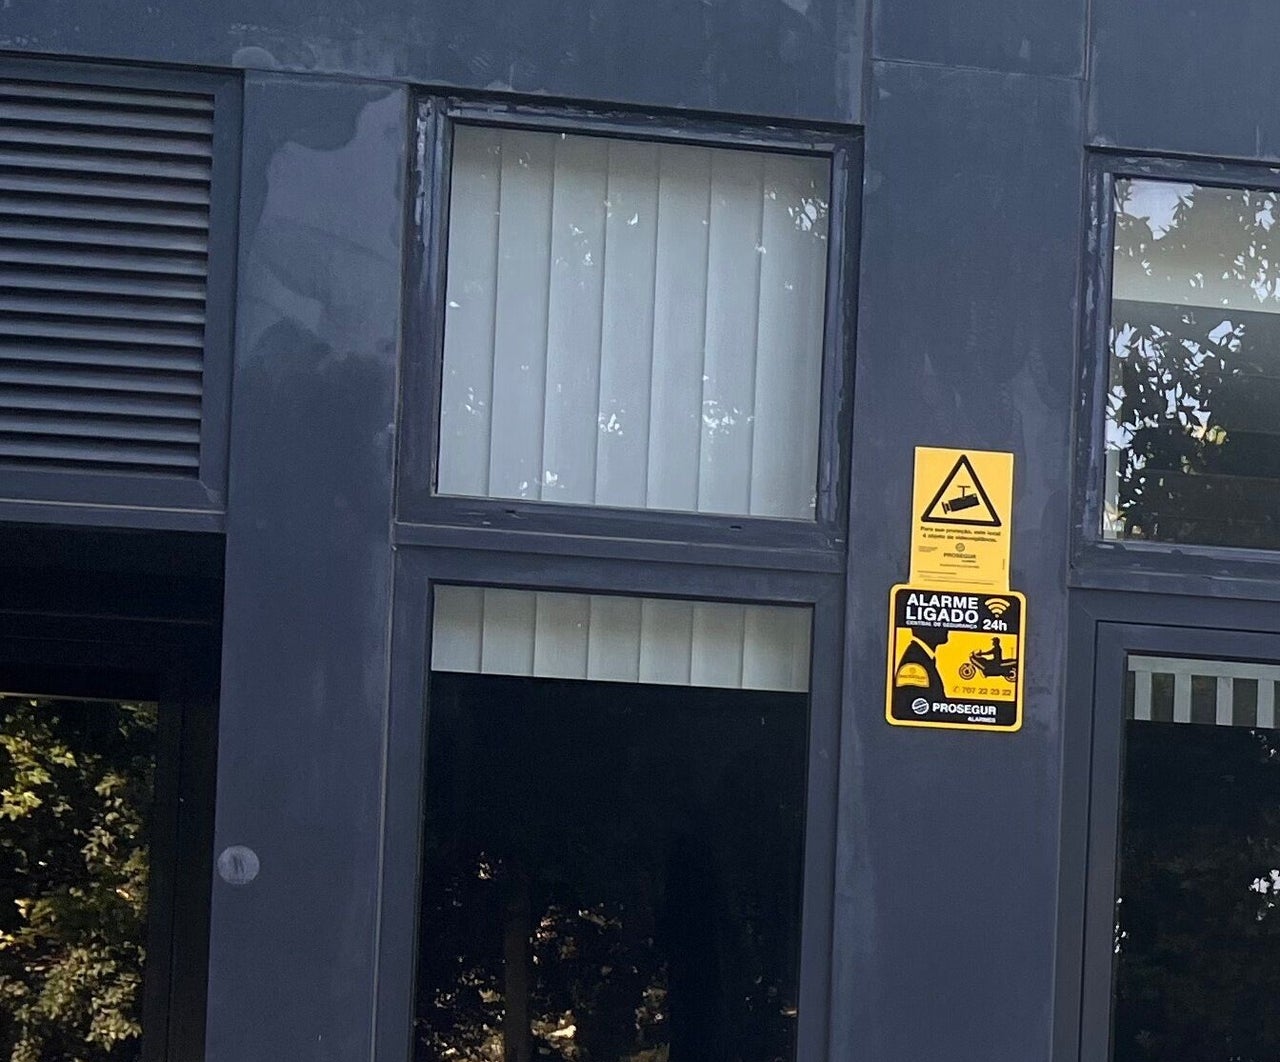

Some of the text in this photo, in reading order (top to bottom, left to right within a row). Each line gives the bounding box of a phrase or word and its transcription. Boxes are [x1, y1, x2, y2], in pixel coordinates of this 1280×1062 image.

[907, 593, 979, 609] ALARME
[906, 606, 1008, 631] LIGADO 24h
[932, 702, 997, 716] PROSEGUR
